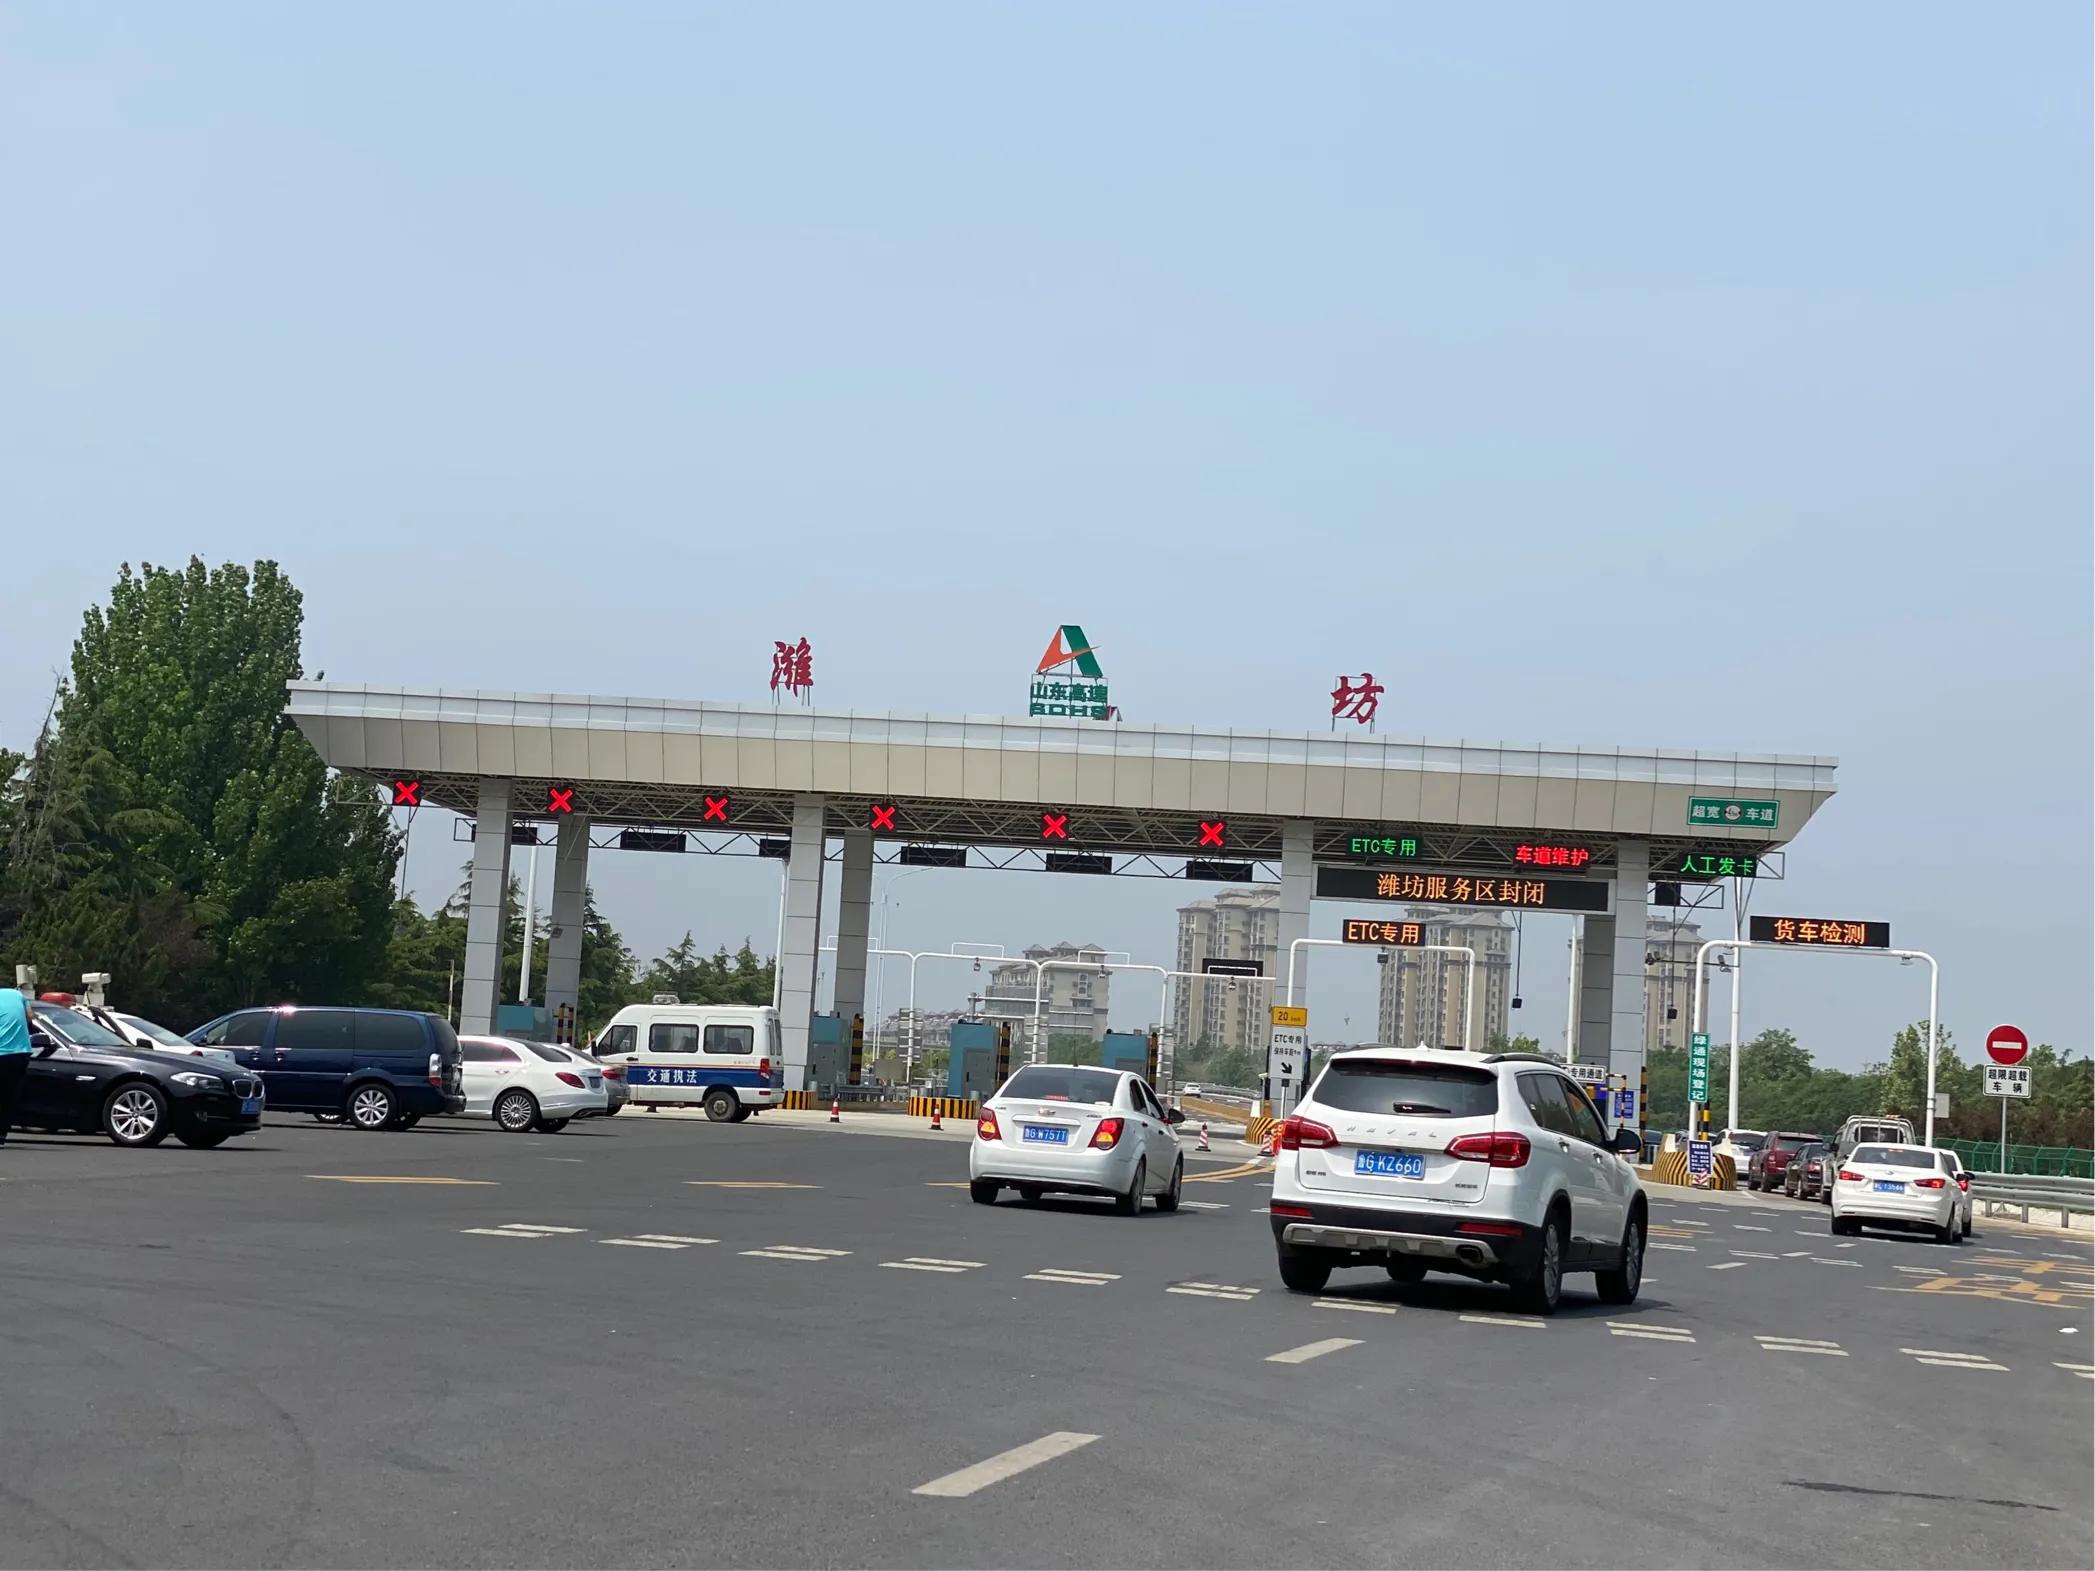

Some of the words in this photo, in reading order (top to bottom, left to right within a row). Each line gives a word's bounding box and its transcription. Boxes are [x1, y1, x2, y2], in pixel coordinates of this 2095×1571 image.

[770, 637, 813, 696] 潍
[1331, 673, 1385, 724] 坊
[1030, 682, 1107, 703] 山东高速
[1745, 807, 1774, 822] 车道
[1351, 837, 1417, 857] ETC专用
[1515, 845, 1590, 867] 车道维护
[1680, 855, 1754, 876] 人工发卡
[1376, 874, 1545, 905] 潍坊服务区封闭
[1346, 921, 1420, 944] ETC专用
[1772, 918, 1867, 944] 货车检测
[1278, 1011, 1289, 1021] 20
[647, 1068, 697, 1084] 交通执法
[1692, 1035, 1707, 1100] 绿通现场登记
[1988, 1069, 2028, 1082] 超限超载
